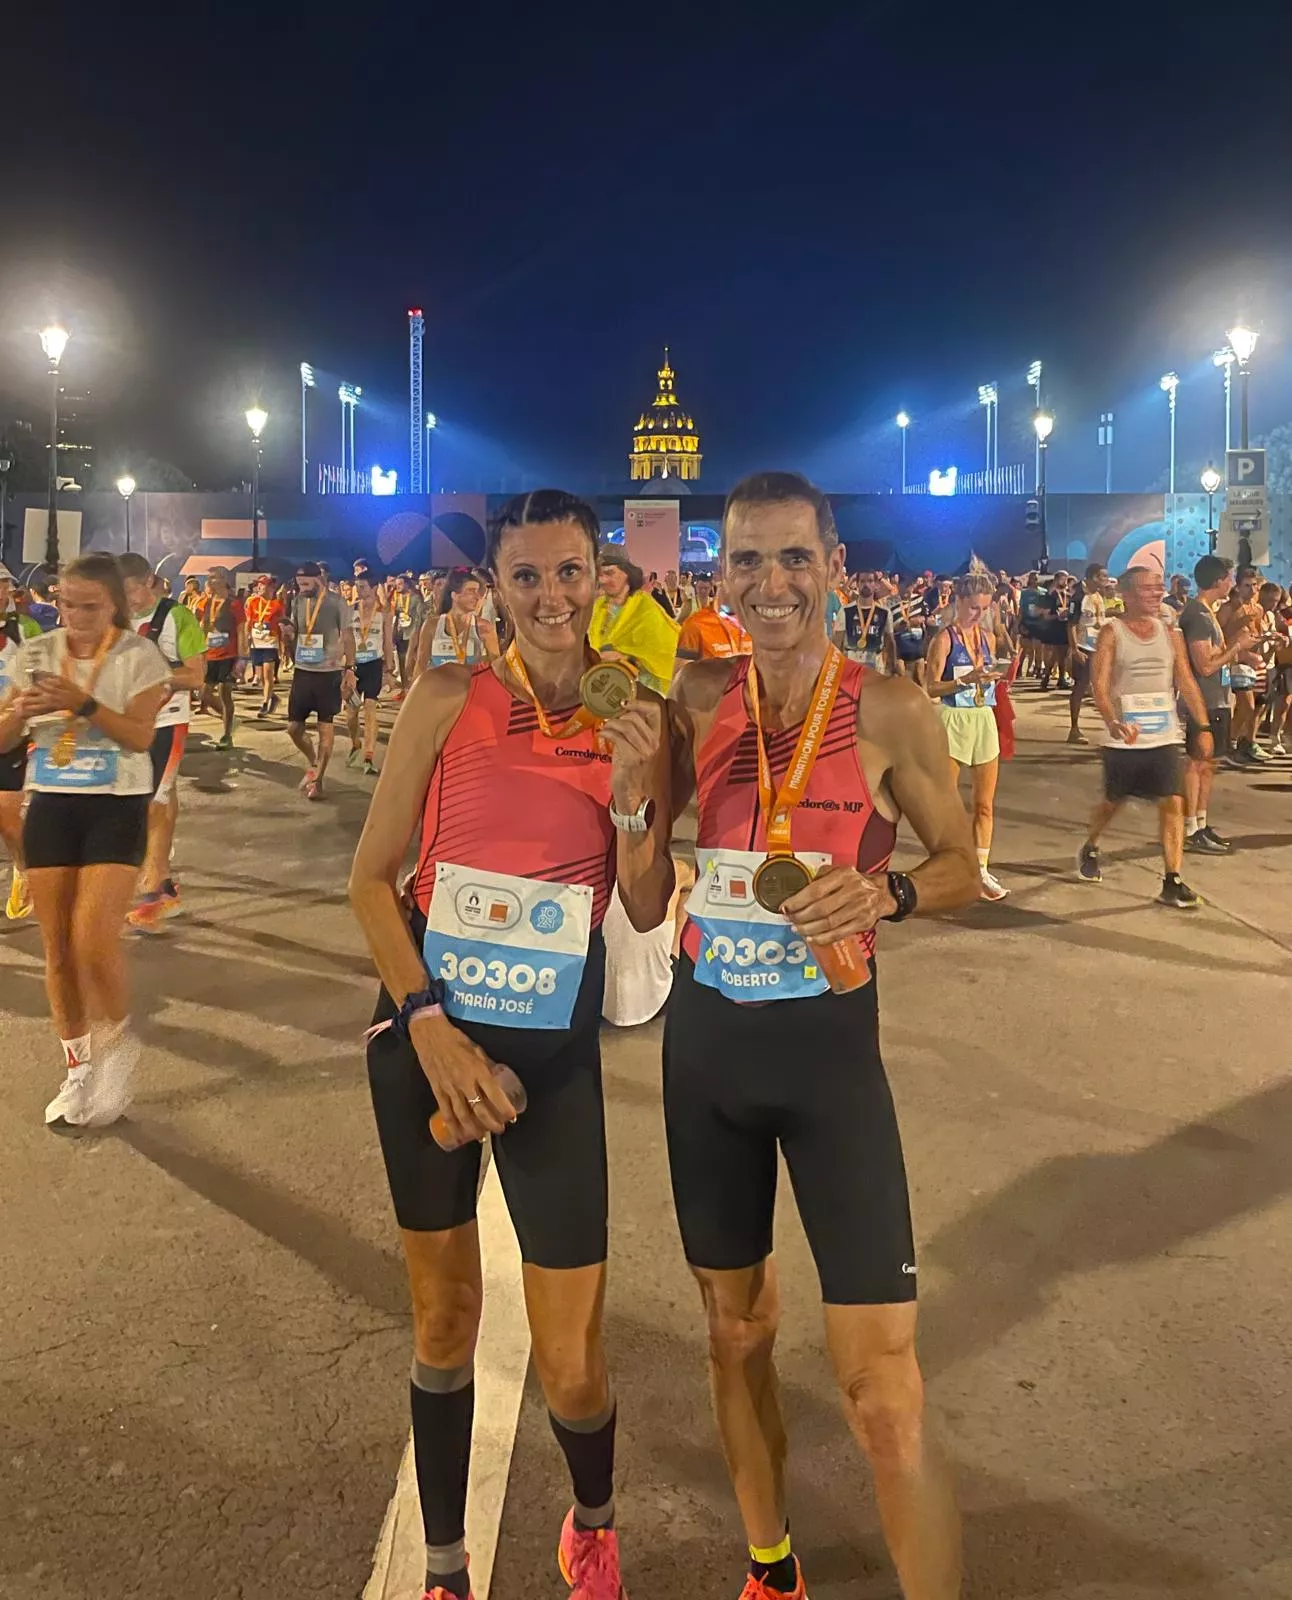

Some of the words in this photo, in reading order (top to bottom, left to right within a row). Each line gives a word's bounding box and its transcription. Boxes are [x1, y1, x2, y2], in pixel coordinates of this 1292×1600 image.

[1237, 458, 1255, 481] P
[788, 738, 815, 790] MARATHON
[808, 713, 824, 740] POUR
[816, 687, 832, 711] TOUS
[824, 664, 838, 686] PARIS
[843, 801, 864, 813] MJP
[440, 952, 557, 996] 30308
[721, 969, 780, 987] ROBERTO
[453, 990, 497, 1011] MARÍA
[499, 998, 534, 1015] JOSÉ
